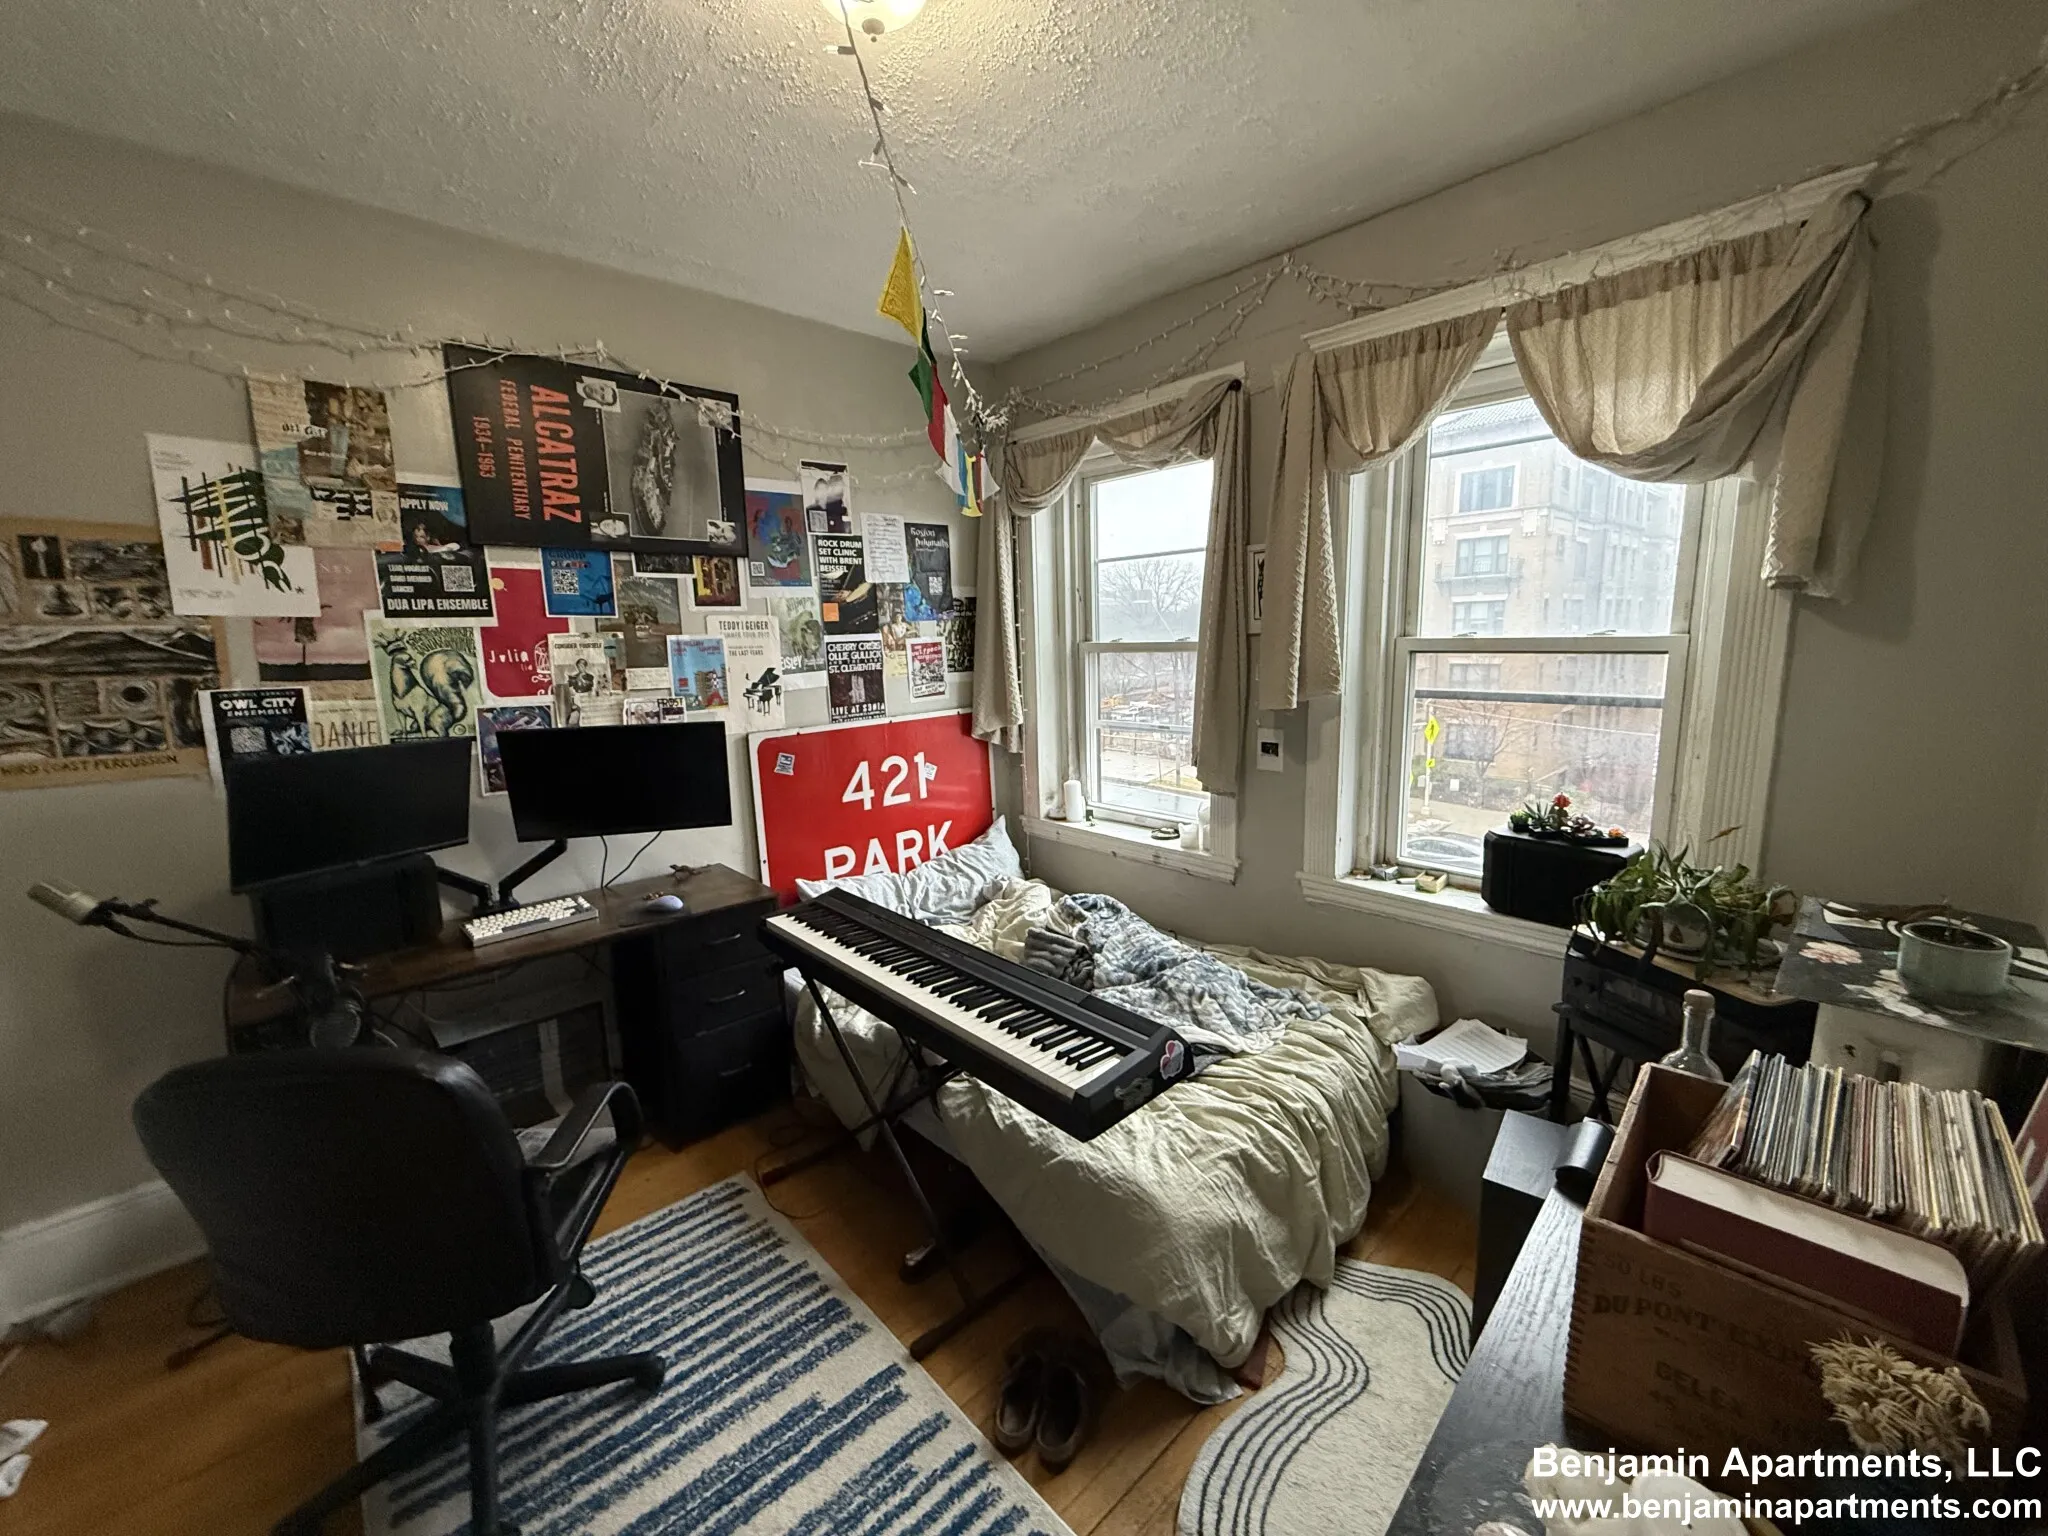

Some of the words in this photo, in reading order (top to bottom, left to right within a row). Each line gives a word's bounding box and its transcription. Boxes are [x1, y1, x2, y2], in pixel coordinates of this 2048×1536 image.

[501, 379, 521, 429] FEDERAL
[473, 416, 496, 478] 1934-1963
[530, 384, 582, 523] ALCATRAZ
[507, 437, 532, 520] PENITENTIARY
[400, 498, 428, 510] APPLY
[429, 500, 449, 511] NOW
[818, 539, 838, 549] ROCK
[840, 540, 862, 550] DRUM
[818, 548, 834, 556] SET
[835, 549, 857, 557] CLINIC
[840, 557, 862, 566] BRENT
[820, 564, 849, 573] BEISSEL
[387, 599, 409, 610] DUA
[411, 599, 435, 610] LIPA
[436, 599, 489, 610] ENSEMBLE
[718, 620, 740, 631] TEDDY
[745, 620, 769, 631] GEIGER
[828, 643, 857, 652] CHERRY
[828, 652, 849, 661] OLLIE
[850, 651, 883, 659] GULLICK
[840, 663, 883, 673] CLEMENTINE
[219, 698, 259, 710] OWL
[262, 697, 297, 709] CITY
[227, 708, 292, 717] ENSEMBLE!
[832, 705, 849, 715] LIVE
[851, 704, 860, 713] AT
[313, 720, 381, 749] DANIE
[0, 763, 39, 776] HIRD
[842, 752, 928, 811] 421
[824, 820, 953, 882] PARK
